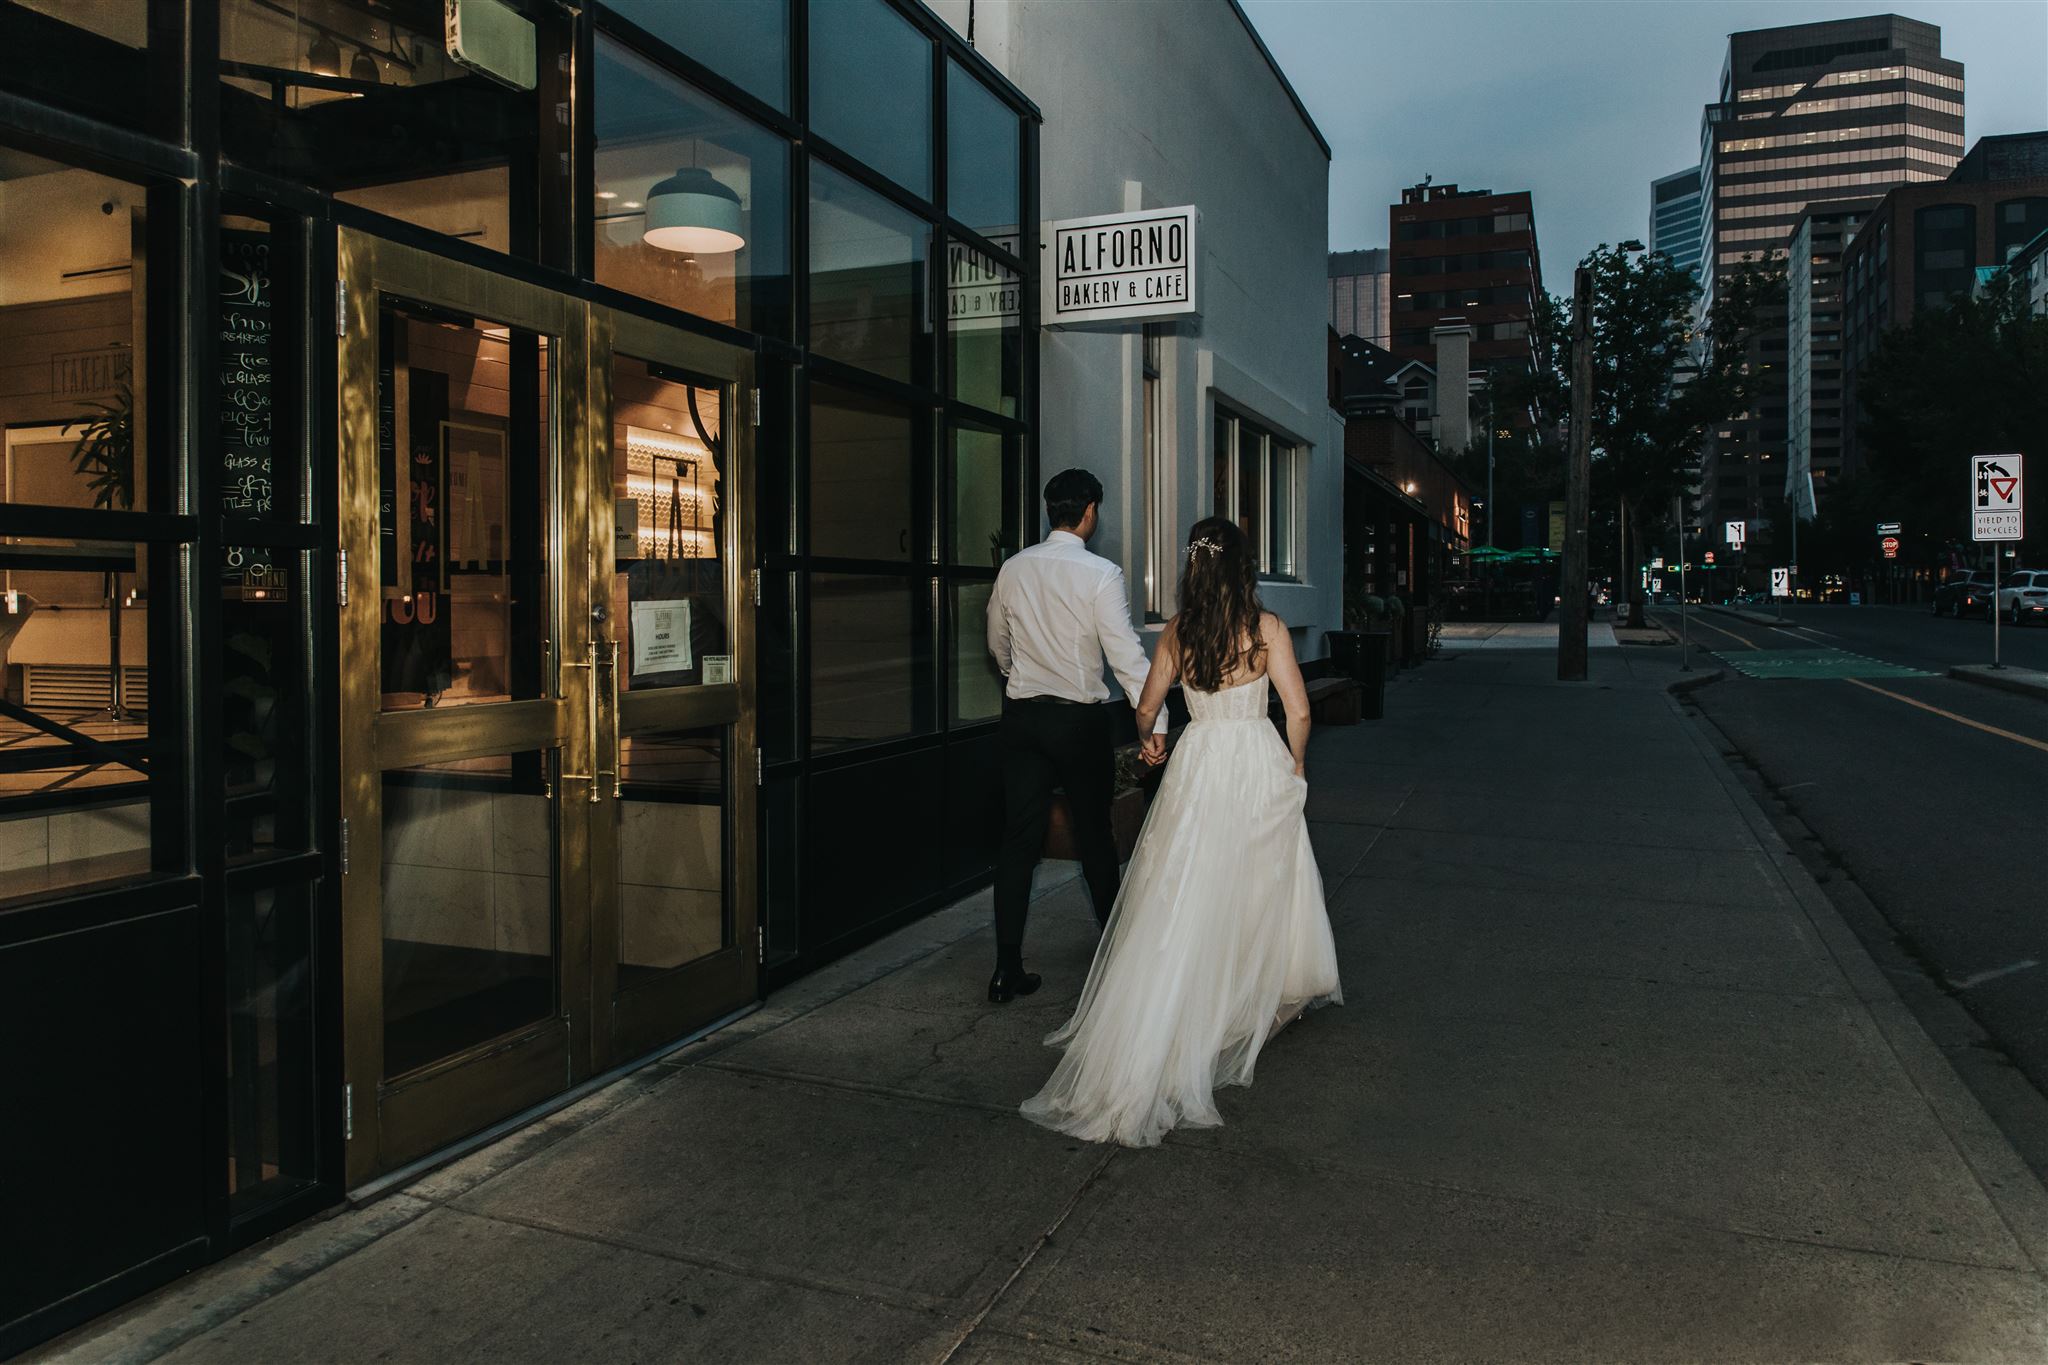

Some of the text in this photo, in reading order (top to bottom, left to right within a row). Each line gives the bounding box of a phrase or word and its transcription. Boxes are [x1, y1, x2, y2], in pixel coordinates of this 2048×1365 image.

[1063, 224, 1181, 273] ALFORNO
[1063, 280, 1119, 306] BAKERY
[1129, 281, 1136, 298] &
[1978, 516, 2001, 524] YIELD
[1978, 526, 2018, 535] BICYCLES
